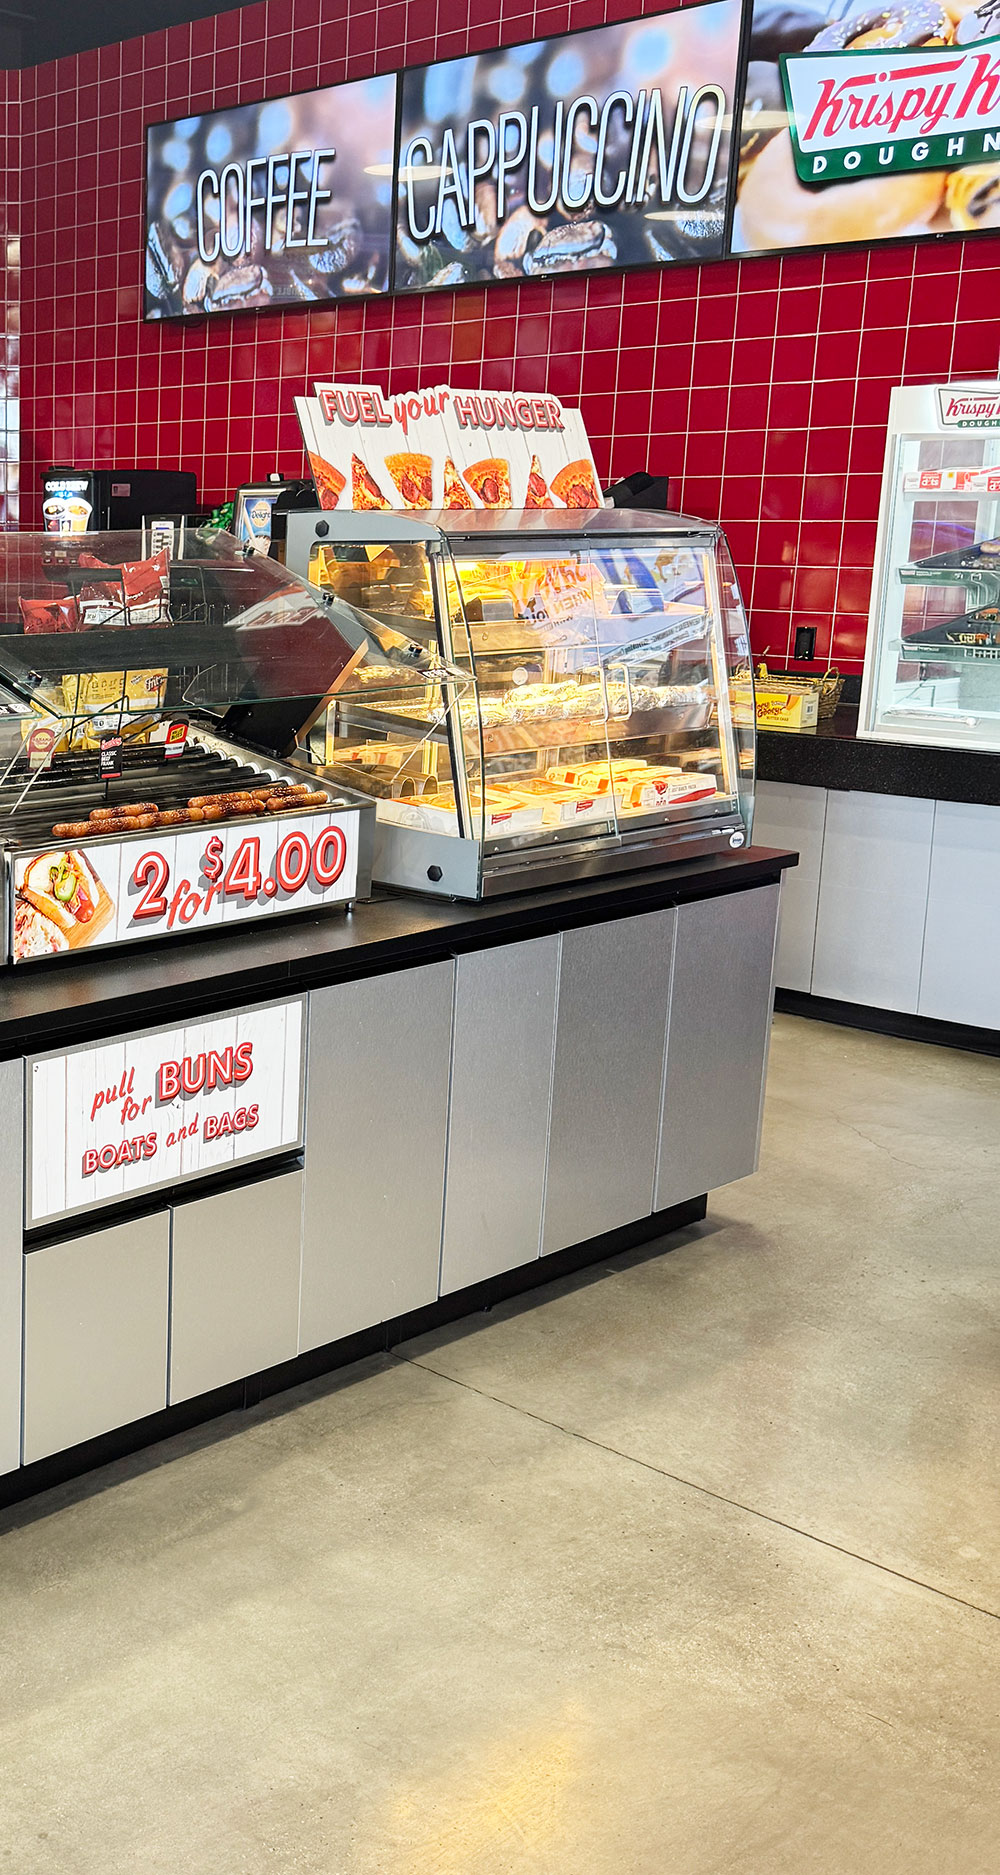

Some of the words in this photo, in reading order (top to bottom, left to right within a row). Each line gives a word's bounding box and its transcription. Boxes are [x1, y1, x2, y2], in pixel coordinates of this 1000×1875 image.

[802, 55, 968, 142] Krispy
[404, 83, 727, 240] CAPPUCCINO
[196, 147, 336, 263] COFFEE
[320, 390, 392, 424] FUEL
[394, 391, 450, 435] your
[453, 396, 565, 430] HUNGER
[946, 396, 999, 418] Krispy
[133, 850, 169, 921] 2
[167, 879, 223, 930] for
[203, 826, 347, 900] $4.00
[90, 1067, 135, 1122] pull
[120, 1096, 152, 1125] for
[159, 1042, 254, 1102] BUNS
[83, 1132, 158, 1176] BOATS
[166, 1112, 199, 1147] and
[205, 1104, 260, 1140] BAGS
